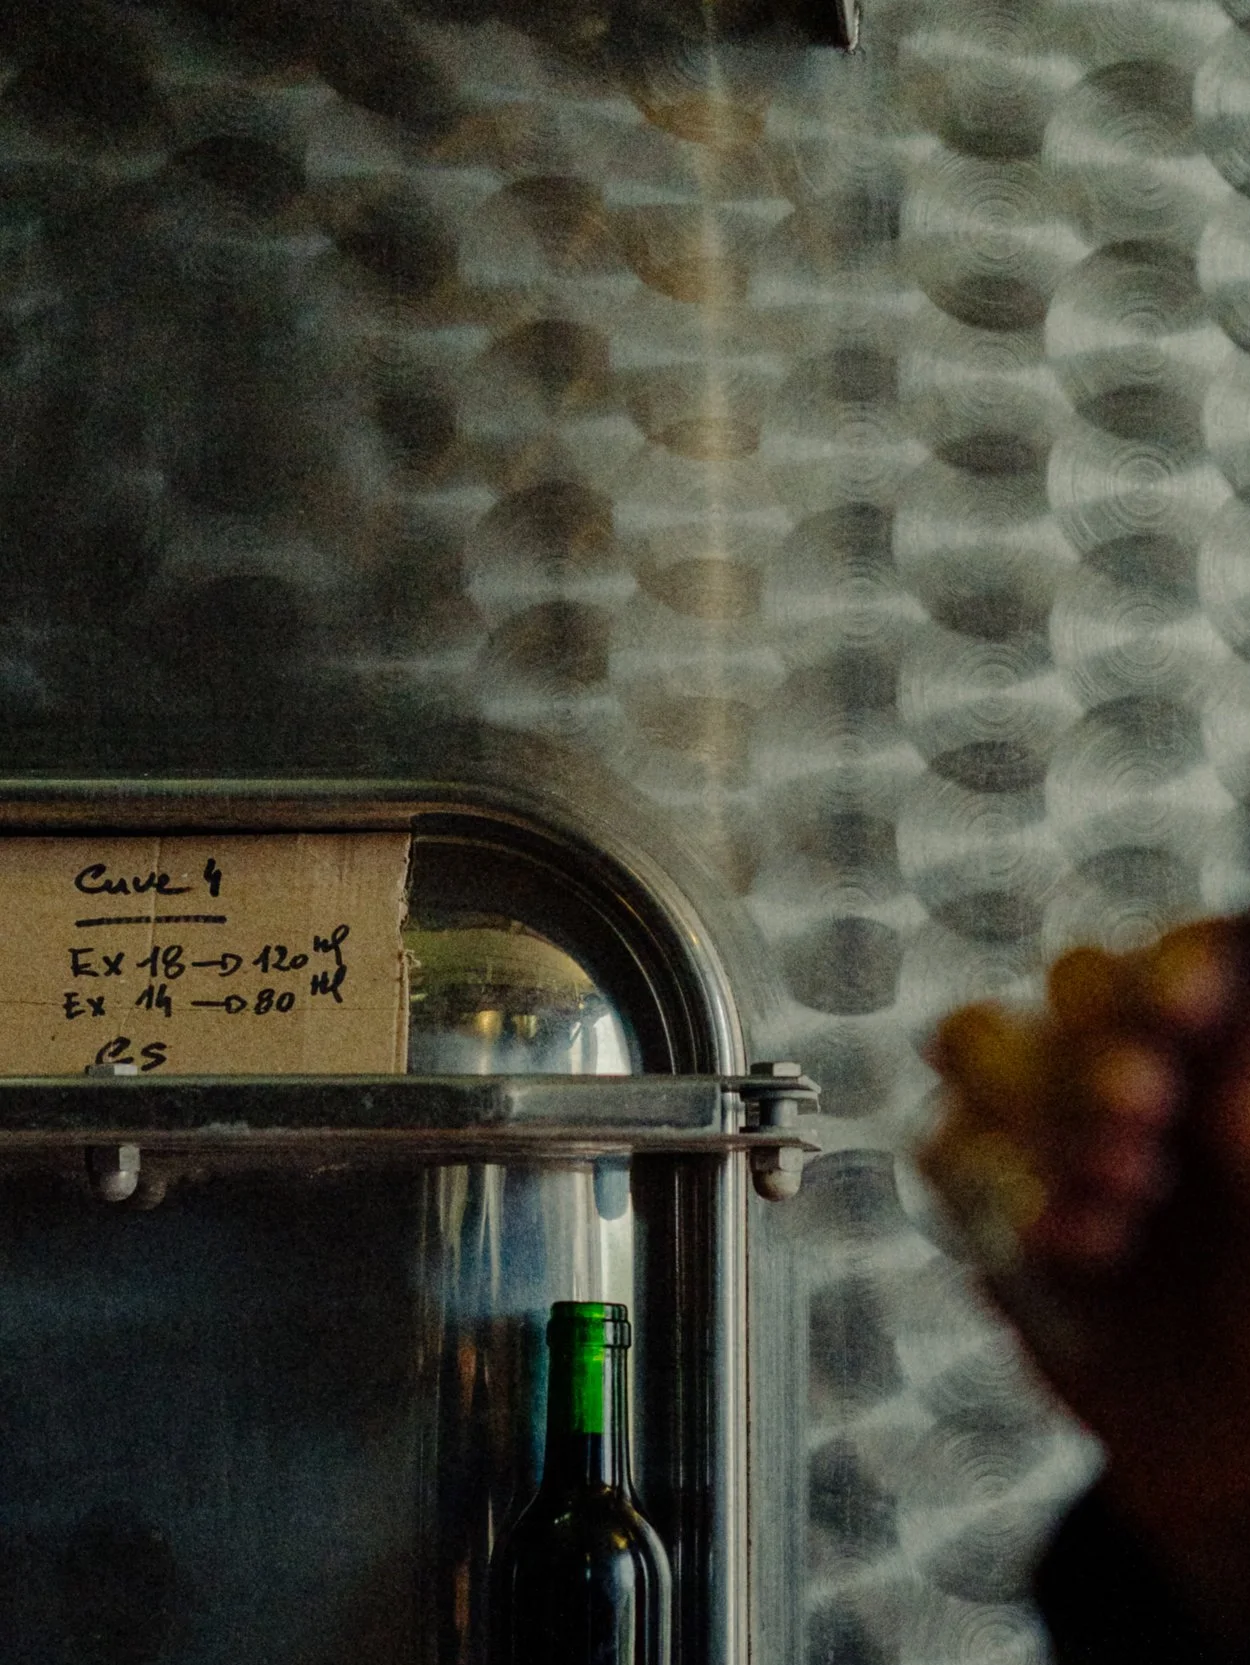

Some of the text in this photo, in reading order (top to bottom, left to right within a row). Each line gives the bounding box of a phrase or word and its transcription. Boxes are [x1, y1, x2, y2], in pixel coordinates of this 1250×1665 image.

[74, 858, 222, 898] Cuve 4
[68, 948, 125, 977] Ex
[137, 945, 186, 980] 18
[62, 991, 106, 1020] Ex
[135, 983, 172, 1018] 14
